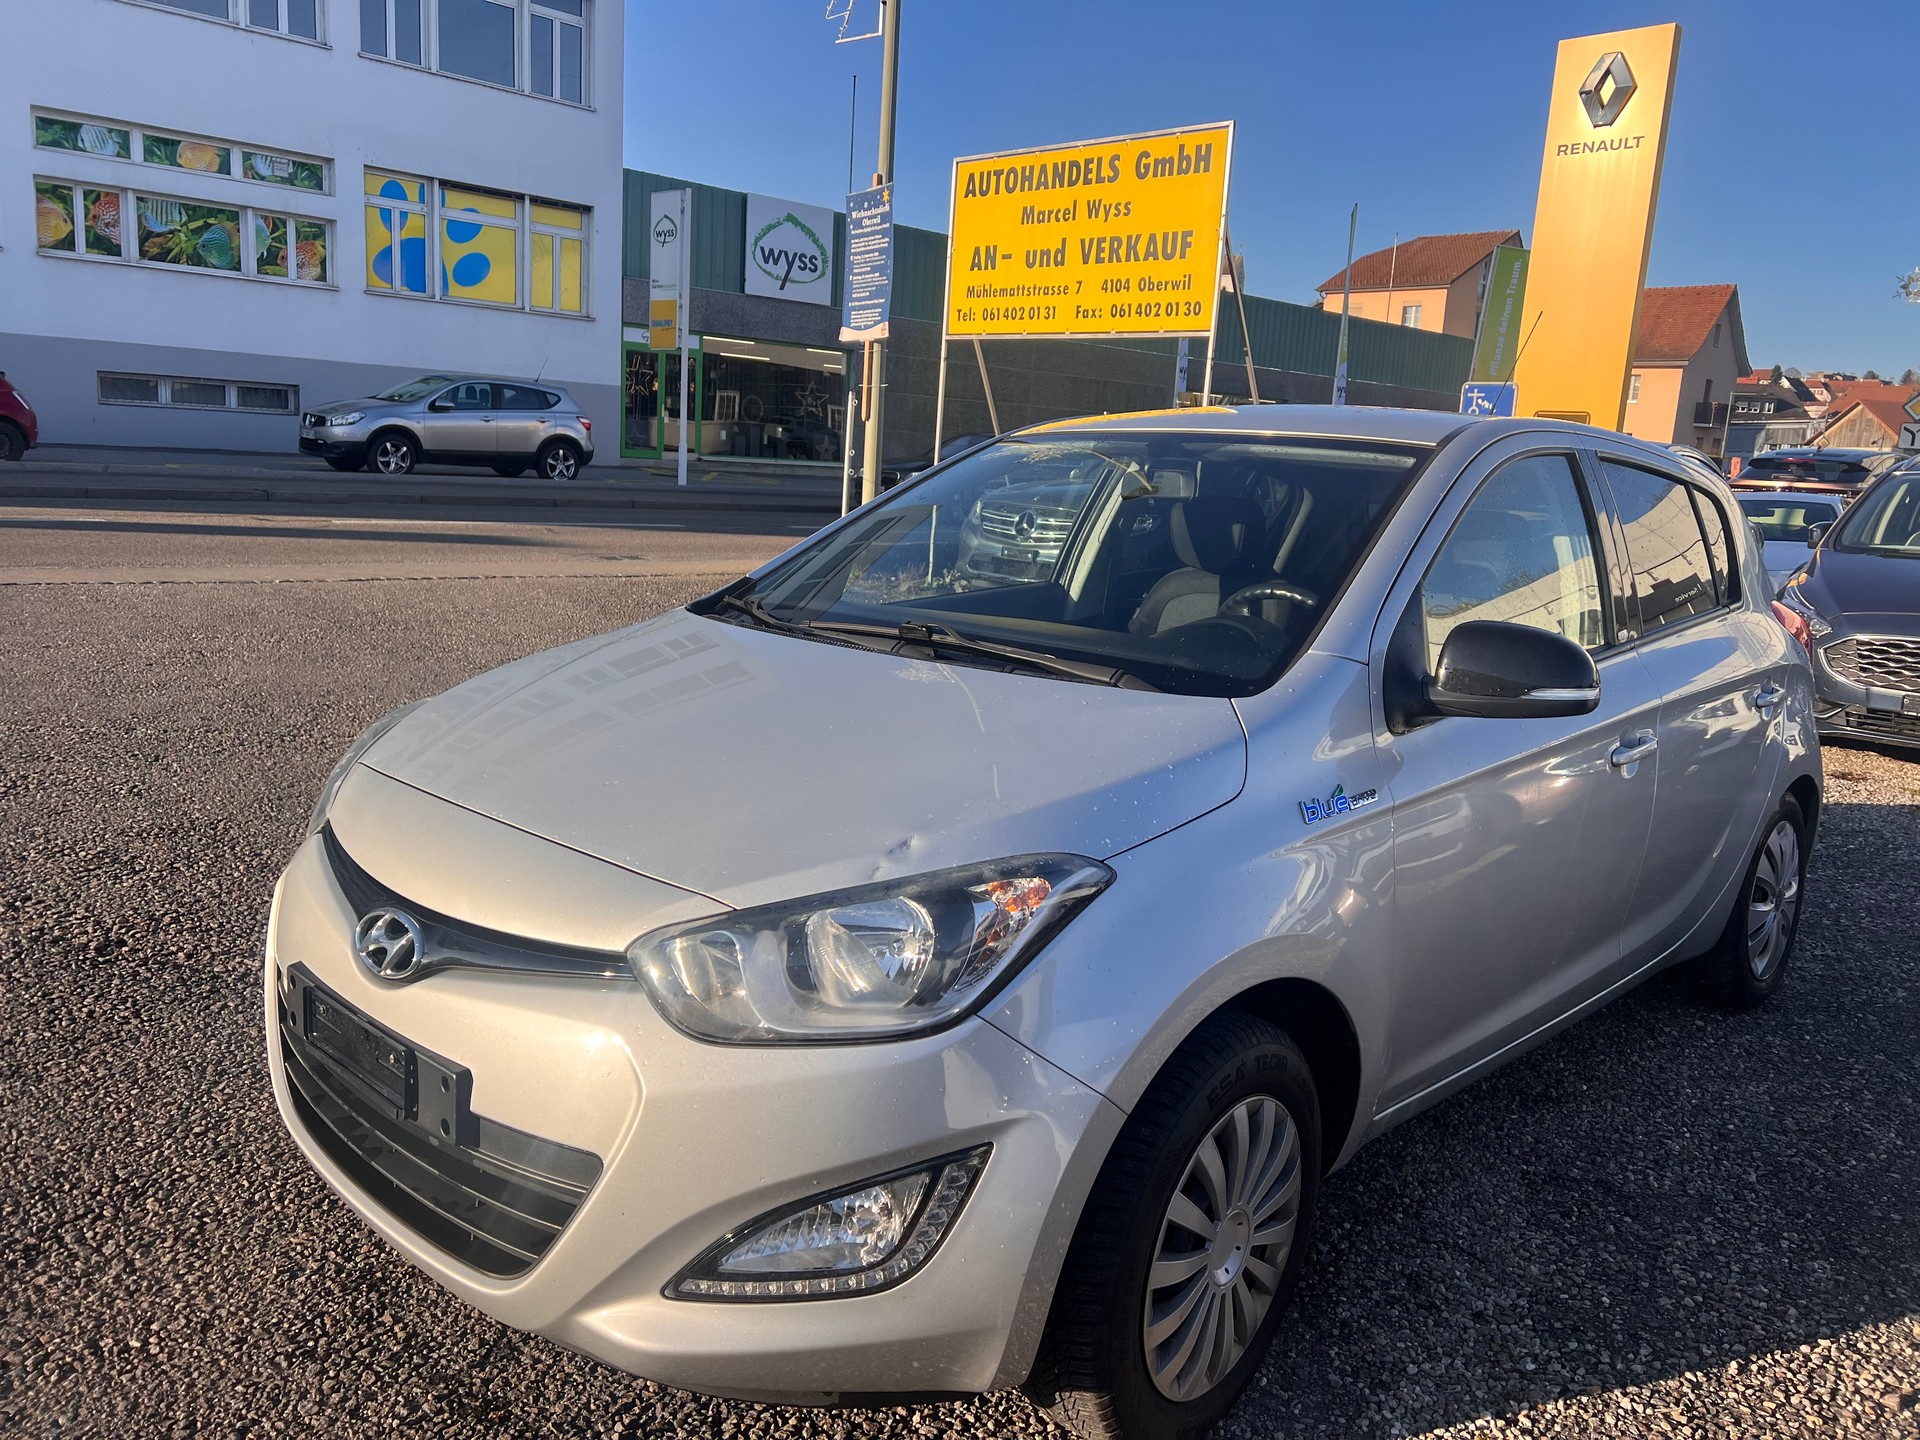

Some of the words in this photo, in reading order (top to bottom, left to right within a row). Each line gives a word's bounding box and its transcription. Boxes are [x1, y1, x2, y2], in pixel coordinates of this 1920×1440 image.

[1556, 135, 1645, 157] RENAULT
[963, 153, 1121, 198] AUTOHANDELS
[1135, 142, 1213, 180] GmbH
[1021, 199, 1078, 225] Marcel
[1086, 198, 1132, 223] Wyss
[656, 229, 675, 248] wyss
[1025, 237, 1067, 269] und
[1080, 229, 1194, 265] VERKAUF
[759, 245, 819, 291] wyss
[966, 283, 1070, 299] Mühlemattstrasse
[1075, 280, 1083, 295] 7
[1101, 278, 1131, 293] 4104
[1138, 273, 1193, 292] Oberwil
[956, 307, 976, 321] Tel:
[1075, 304, 1103, 319] Fax:
[1489, 335, 1505, 376] Pflanze
[1498, 296, 1513, 335] deinen
[1506, 258, 1523, 295] Traum.
[1300, 794, 1350, 825] blue
